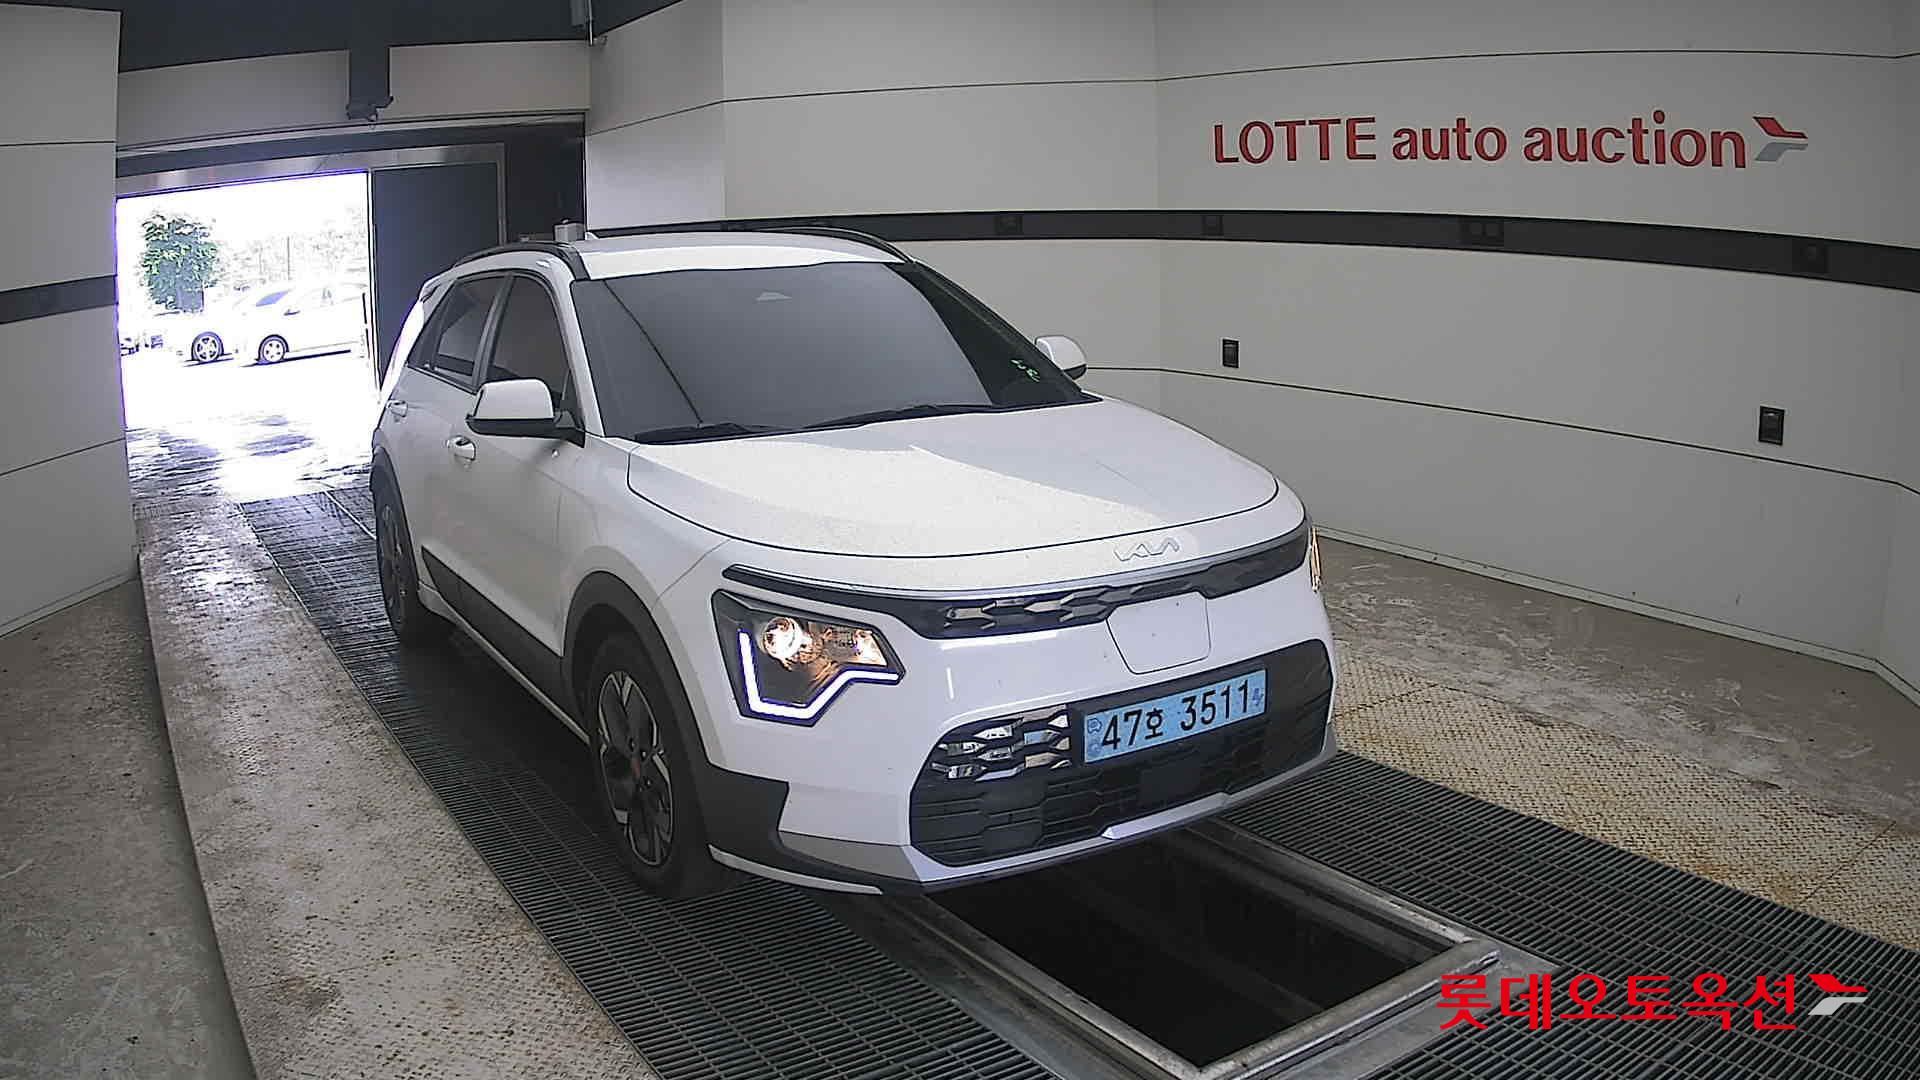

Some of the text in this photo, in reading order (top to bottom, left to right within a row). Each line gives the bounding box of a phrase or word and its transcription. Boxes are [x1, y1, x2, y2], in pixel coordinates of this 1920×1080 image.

[1213, 110, 1747, 169] LOTTE auto auction
[1101, 679, 1249, 750] 47호 3511
